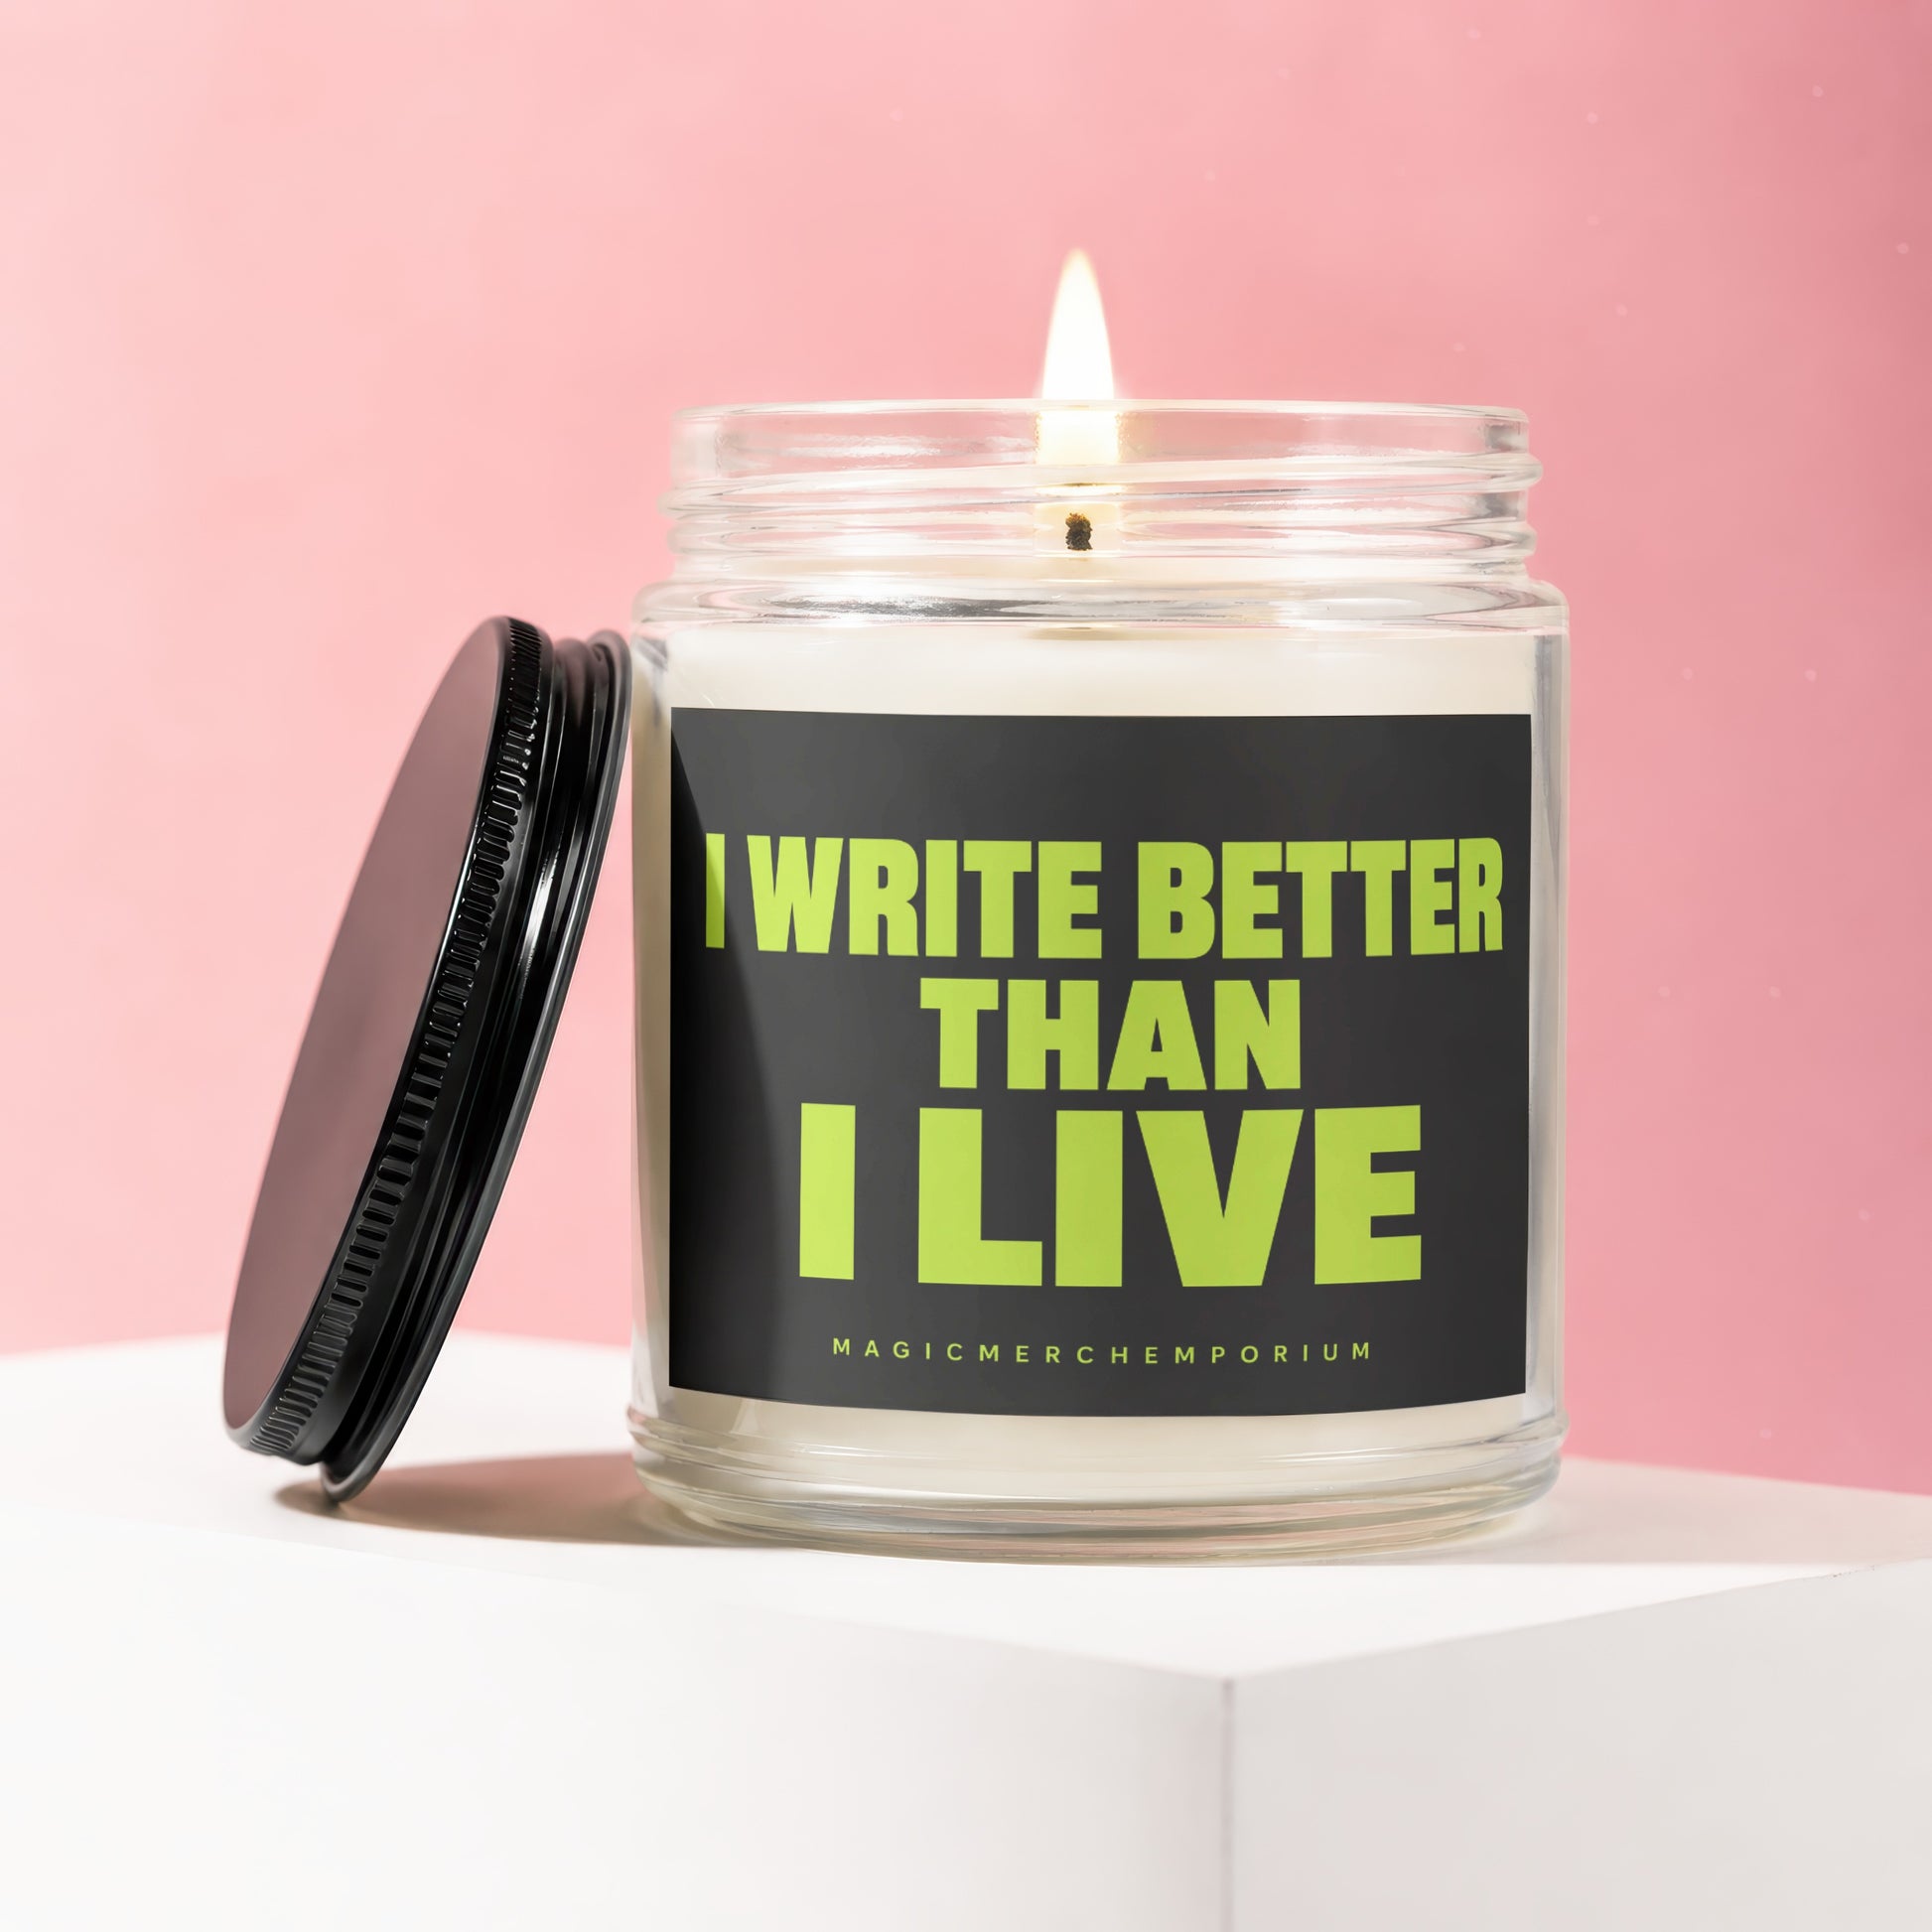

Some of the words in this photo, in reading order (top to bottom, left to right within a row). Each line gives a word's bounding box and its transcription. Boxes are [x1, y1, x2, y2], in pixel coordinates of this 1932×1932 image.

[705, 832, 726, 949] I
[746, 834, 1103, 960] WRITE
[1137, 837, 1503, 960] BETTER
[918, 976, 1302, 1091] THAN
[798, 1102, 857, 1282] I
[916, 1104, 1423, 1288] LIVE
[831, 1336, 1373, 1365] MAGICMERCHEMPORIUM
